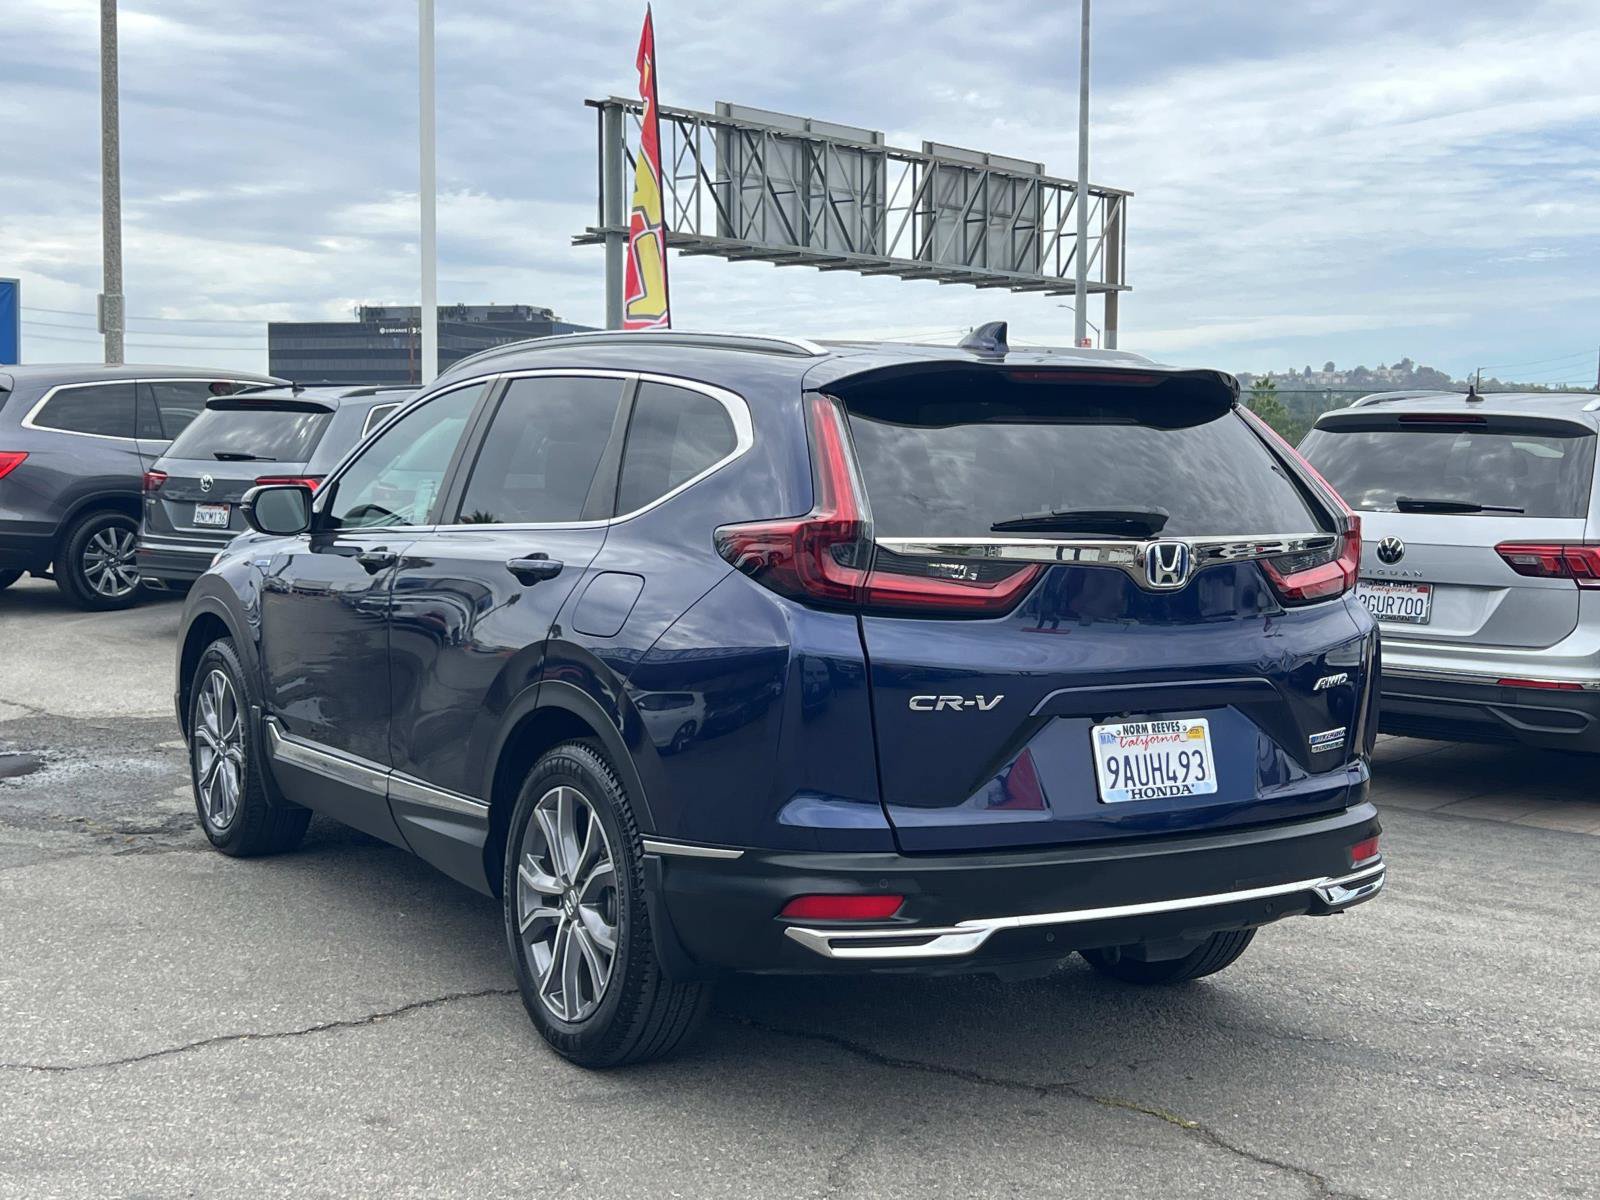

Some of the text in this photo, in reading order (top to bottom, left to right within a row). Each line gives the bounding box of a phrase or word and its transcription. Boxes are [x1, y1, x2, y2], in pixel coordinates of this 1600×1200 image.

[1313, 672, 1348, 690] AWD
[908, 694, 1005, 711] CR-V
[1122, 721, 1180, 736] NORM REEVES
[1119, 733, 1180, 751] California
[1106, 749, 1206, 789] 9AUH493
[1131, 784, 1193, 799] HONDA
